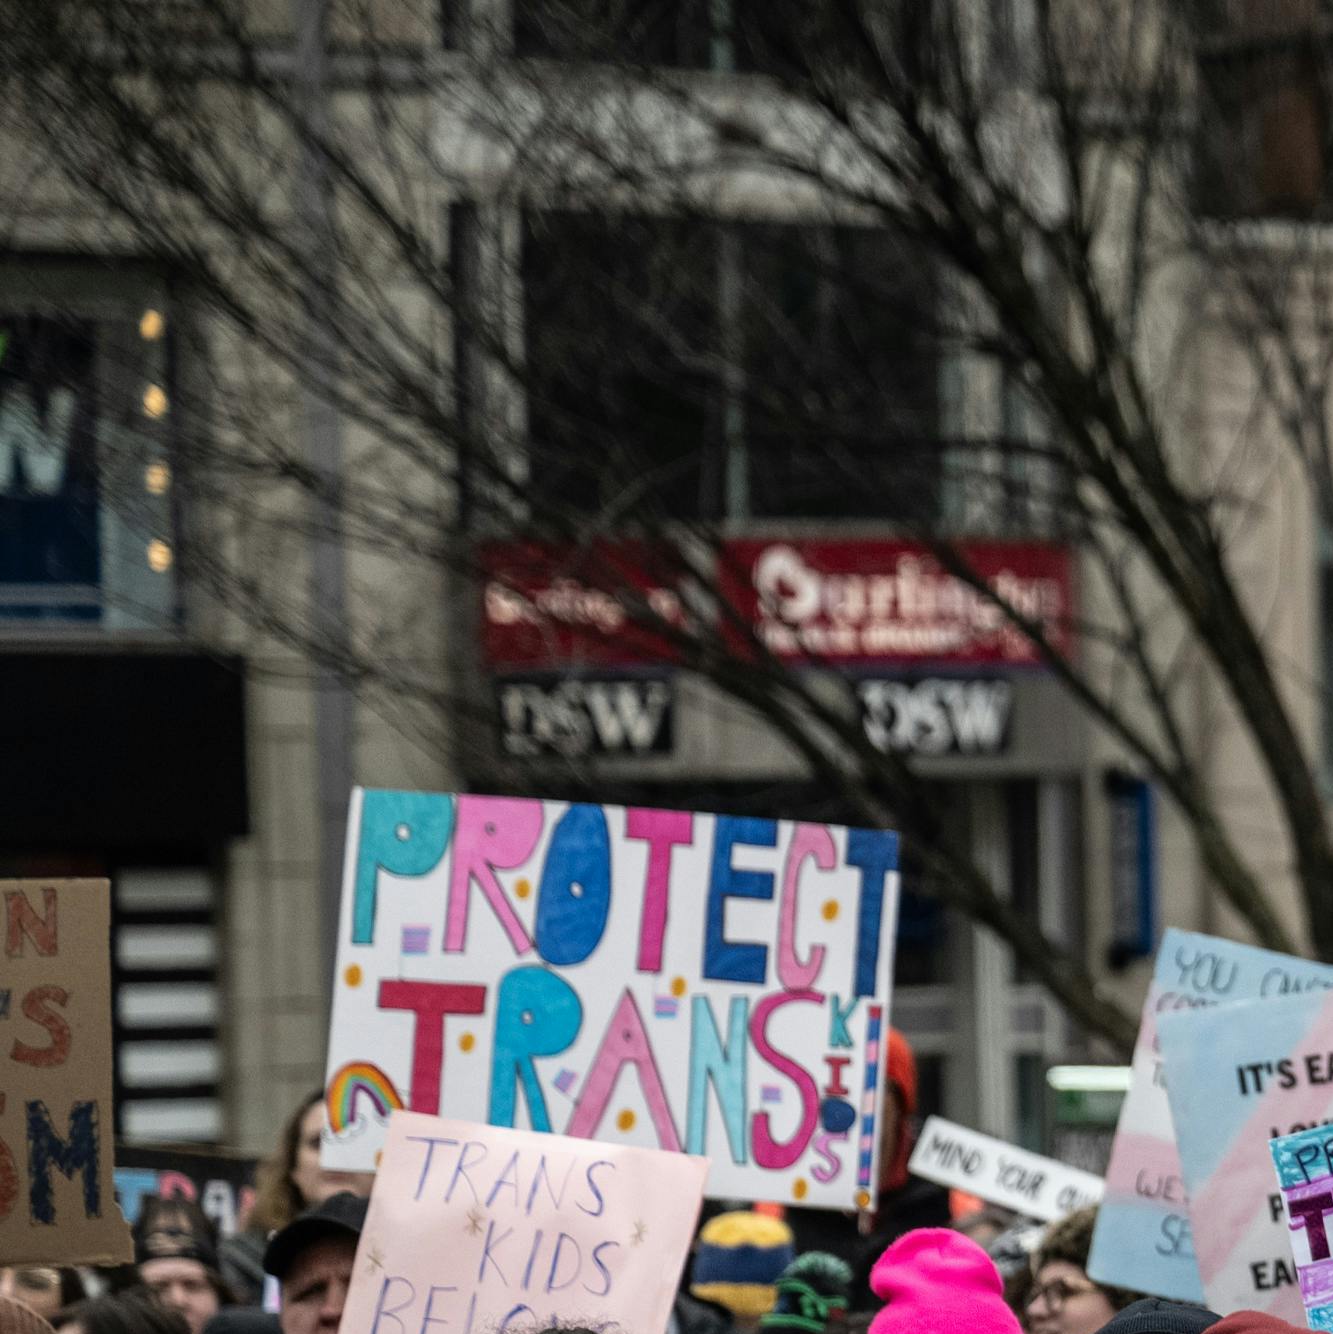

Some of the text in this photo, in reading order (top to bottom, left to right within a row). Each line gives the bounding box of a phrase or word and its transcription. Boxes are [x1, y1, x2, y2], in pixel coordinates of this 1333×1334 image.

[351, 788, 900, 997] PROTECT
[378, 963, 826, 1171] TRANS
[1236, 1058, 1298, 1096] IT'S
[405, 1135, 616, 1217] TRANS
[926, 1132, 983, 1178] MIND
[478, 1219, 620, 1298] KIDS
